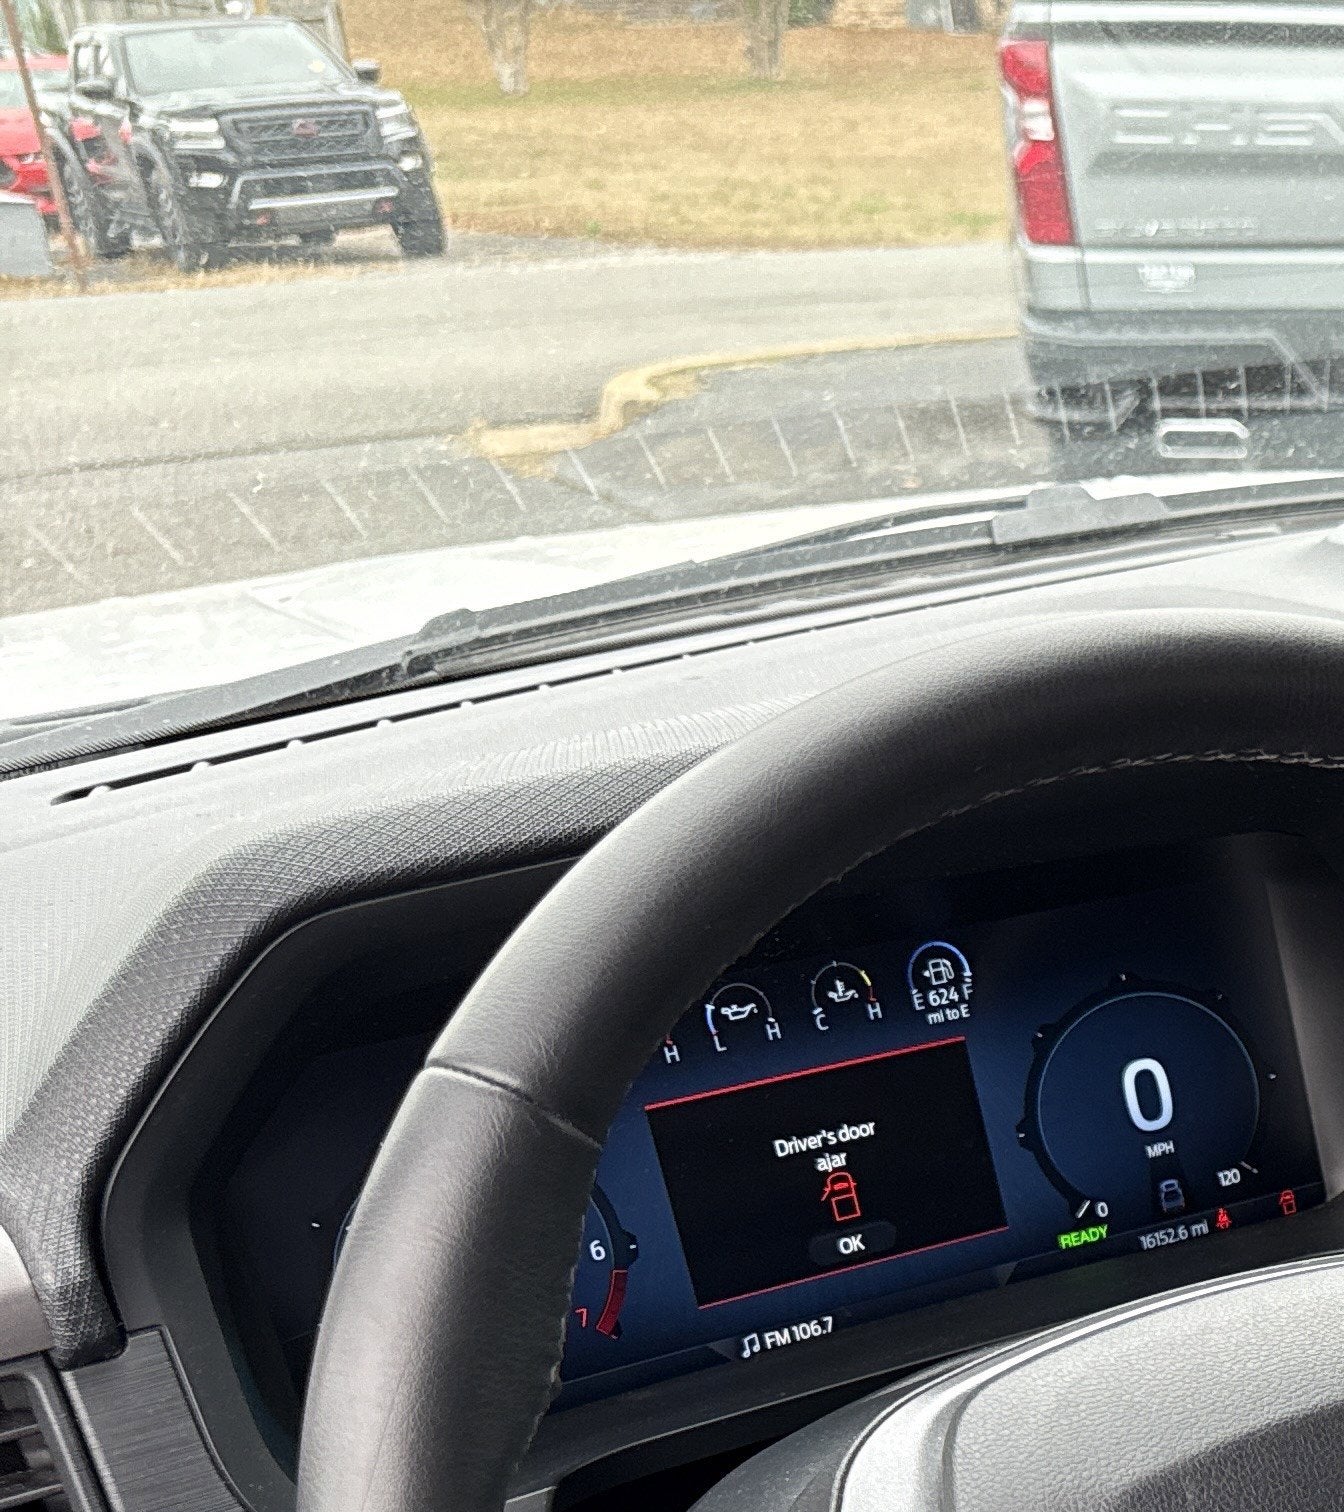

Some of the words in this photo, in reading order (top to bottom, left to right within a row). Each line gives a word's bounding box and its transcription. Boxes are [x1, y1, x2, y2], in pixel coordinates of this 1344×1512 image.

[928, 985, 960, 1006] 624
[963, 981, 974, 1000] F
[867, 1001, 883, 1021] H
[913, 992, 926, 1011] E
[815, 1012, 830, 1032] C
[927, 1009, 945, 1025] mi
[946, 1007, 960, 1021] to
[961, 1004, 971, 1018] E
[766, 1021, 782, 1041] H
[713, 1034, 727, 1052] L
[663, 1044, 680, 1064] H
[1121, 1057, 1174, 1132] 0
[773, 1129, 837, 1158] Driver's
[837, 1120, 876, 1143] door
[1145, 1140, 1175, 1159] MPH
[814, 1151, 848, 1172] ajar
[1216, 1167, 1242, 1187] 120
[1095, 1201, 1109, 1218] 0
[836, 1233, 866, 1255] OK
[1057, 1223, 1109, 1250] READY
[1139, 1226, 1188, 1251] 16152.6
[1190, 1218, 1210, 1236] mi
[589, 1239, 606, 1261] 6
[574, 1307, 588, 1328] 7
[763, 1326, 792, 1350] FM
[792, 1315, 834, 1342] 106.7
